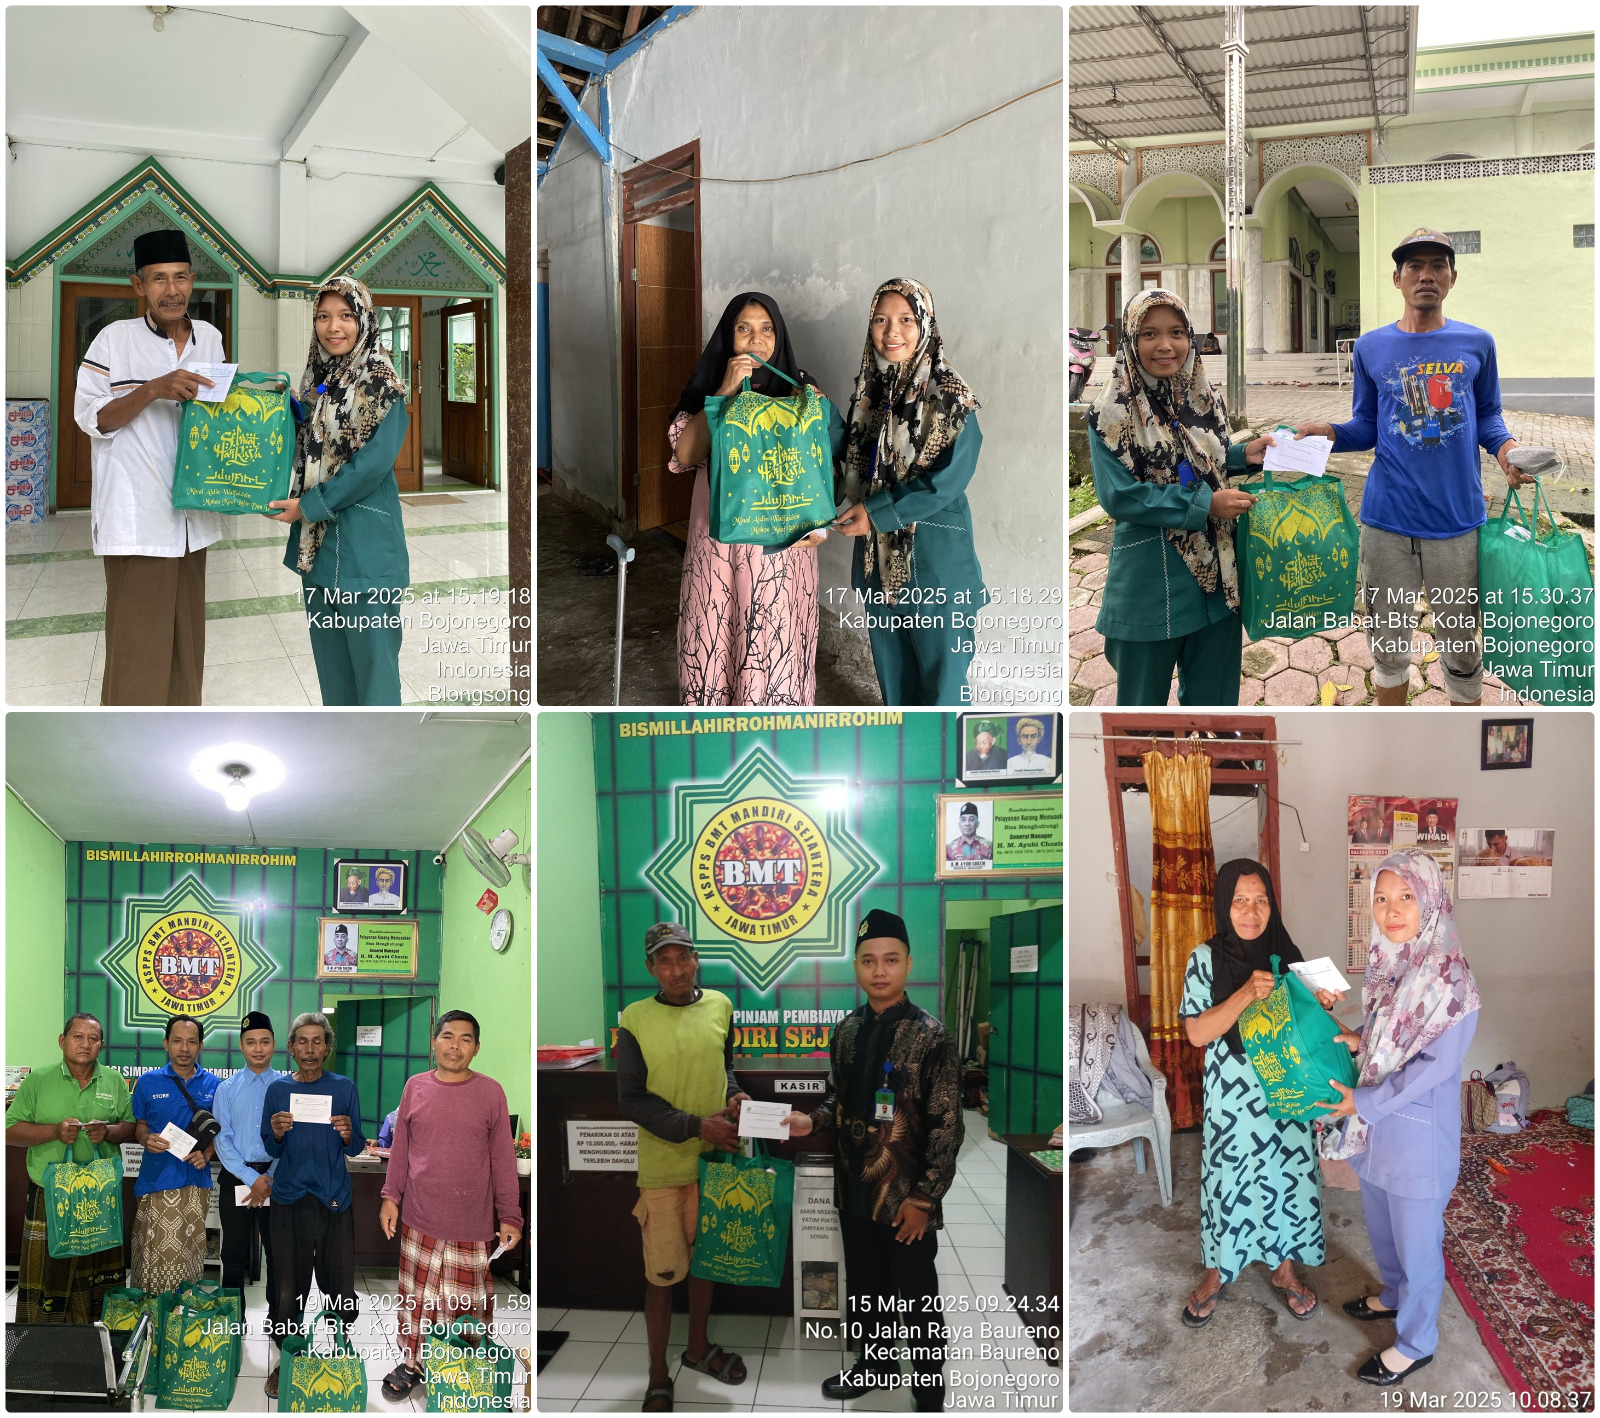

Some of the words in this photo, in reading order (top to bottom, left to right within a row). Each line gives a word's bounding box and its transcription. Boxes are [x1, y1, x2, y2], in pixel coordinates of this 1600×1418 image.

[1416, 362, 1464, 376] SELVA
[619, 712, 904, 738] BISMILLAHIRROHMANIRROHIM
[730, 806, 792, 824] MANDIRI
[705, 820, 728, 848] BMT
[1416, 832, 1450, 840] WIHADI
[86, 850, 296, 866] BISMILLAHIRROHMANIRROHIM
[794, 820, 822, 898] SEJAHTERA
[699, 854, 715, 900] KSPPS
[720, 858, 801, 886] BMT
[725, 916, 756, 936] JAWA
[760, 914, 798, 936] TIMUR
[142, 950, 154, 984] KSPPS
[148, 926, 166, 946] BMT
[168, 918, 214, 932] MANDIRI
[214, 930, 236, 987] SEJAHTERA
[159, 956, 220, 976] BMT
[161, 996, 184, 1012] JAWA
[187, 998, 216, 1012] TIMUR
[733, 1010, 778, 1024] PINJAM
[780, 1082, 820, 1090] KASIR
